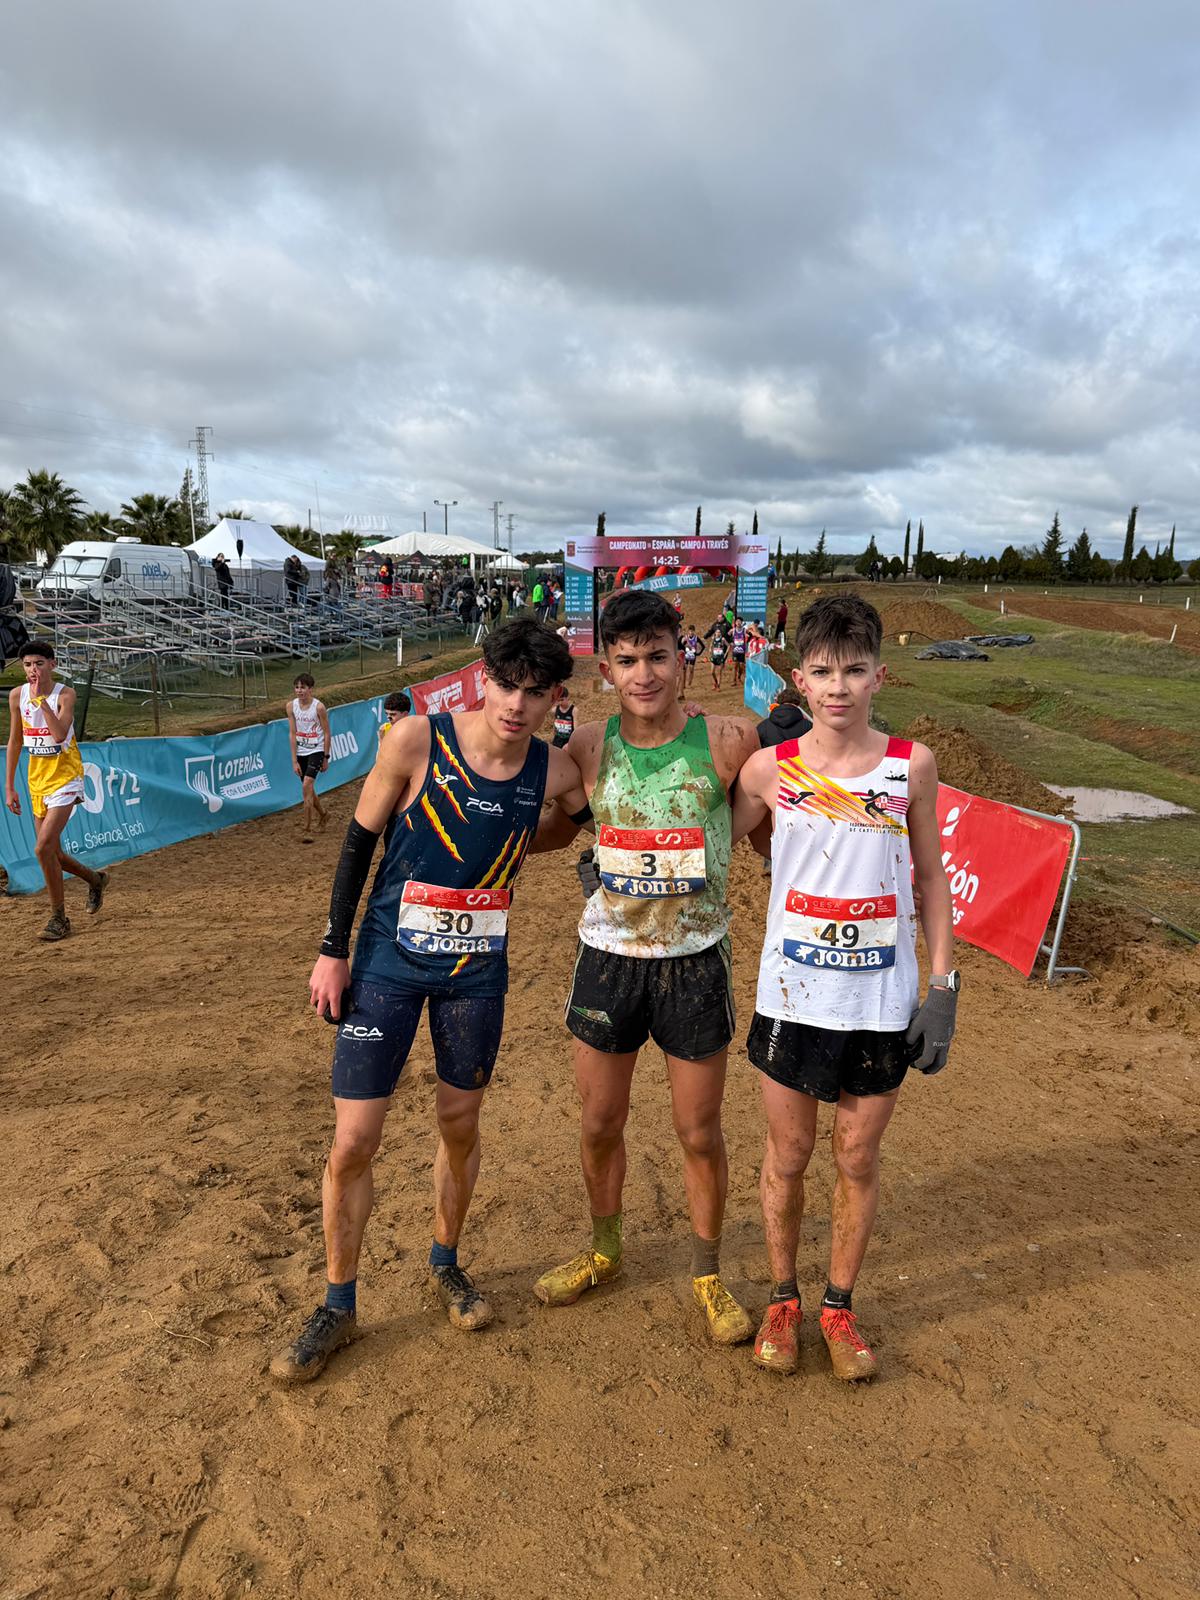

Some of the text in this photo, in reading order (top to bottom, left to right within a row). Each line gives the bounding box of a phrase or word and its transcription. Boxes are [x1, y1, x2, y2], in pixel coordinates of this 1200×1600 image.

[609, 541, 647, 550] CAMPEONATO
[652, 538, 676, 549] ESPAÑA
[680, 540, 700, 549] CAMPO
[701, 540, 706, 549] A
[706, 538, 729, 549] TRAVÉS
[652, 555, 680, 565] 14:25
[32, 737, 45, 747] 72
[328, 731, 358, 763] NDO
[218, 751, 264, 781] LOTERÍAS
[64, 821, 145, 855] ife_Science_Tech
[641, 853, 657, 876] 3
[629, 879, 692, 895] Joma
[434, 911, 473, 935] 30
[427, 936, 491, 952] Joma
[820, 923, 860, 948] 49
[814, 948, 882, 967] Joma
